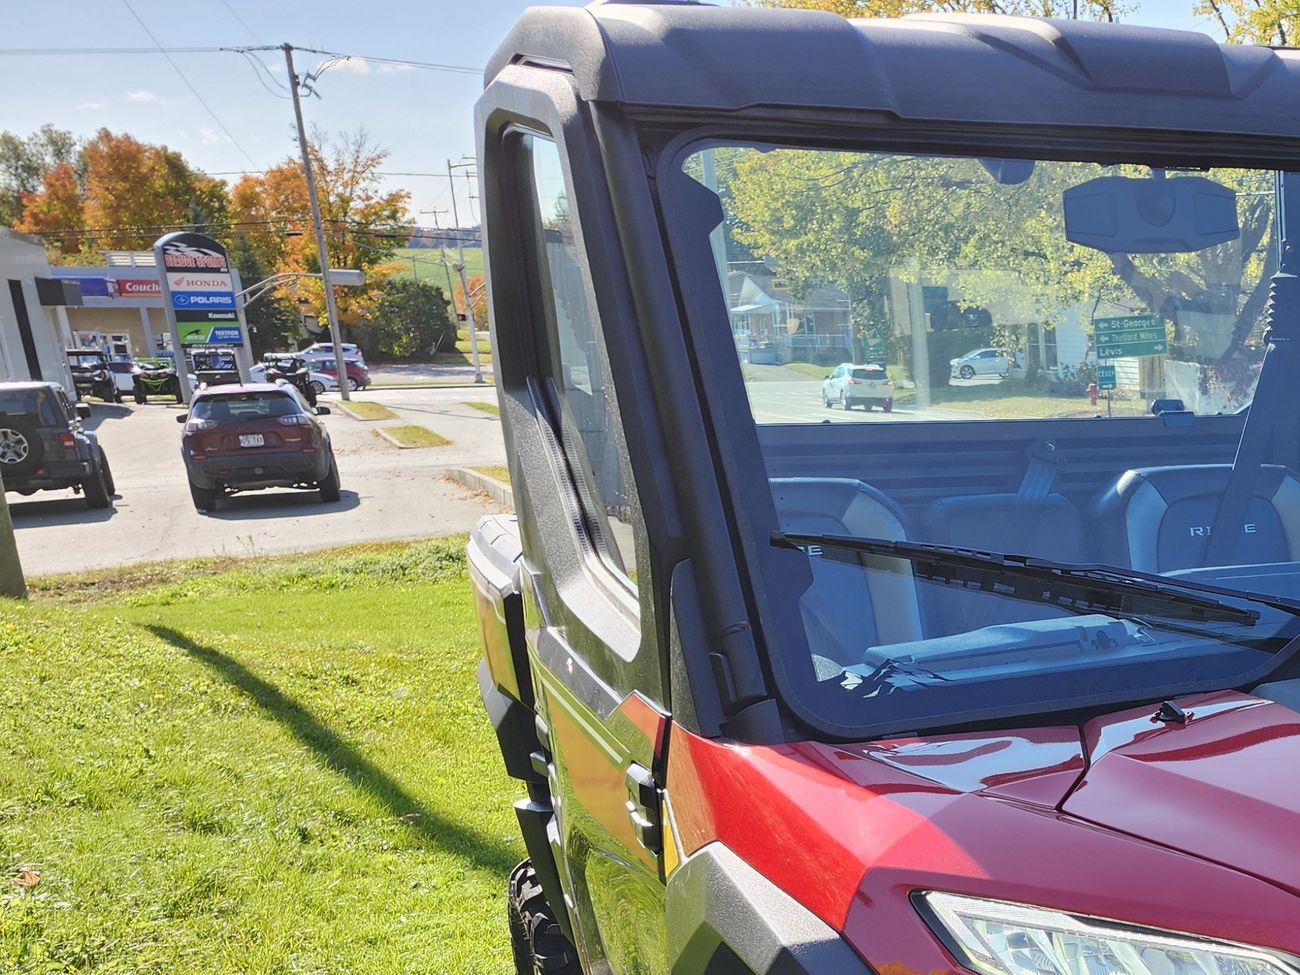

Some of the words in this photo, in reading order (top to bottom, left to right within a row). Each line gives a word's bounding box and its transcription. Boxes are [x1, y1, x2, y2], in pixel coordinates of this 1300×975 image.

[190, 296, 232, 304] POLARIS
[1111, 319, 1156, 329] St-Georges
[1190, 523, 1257, 537] RIE
